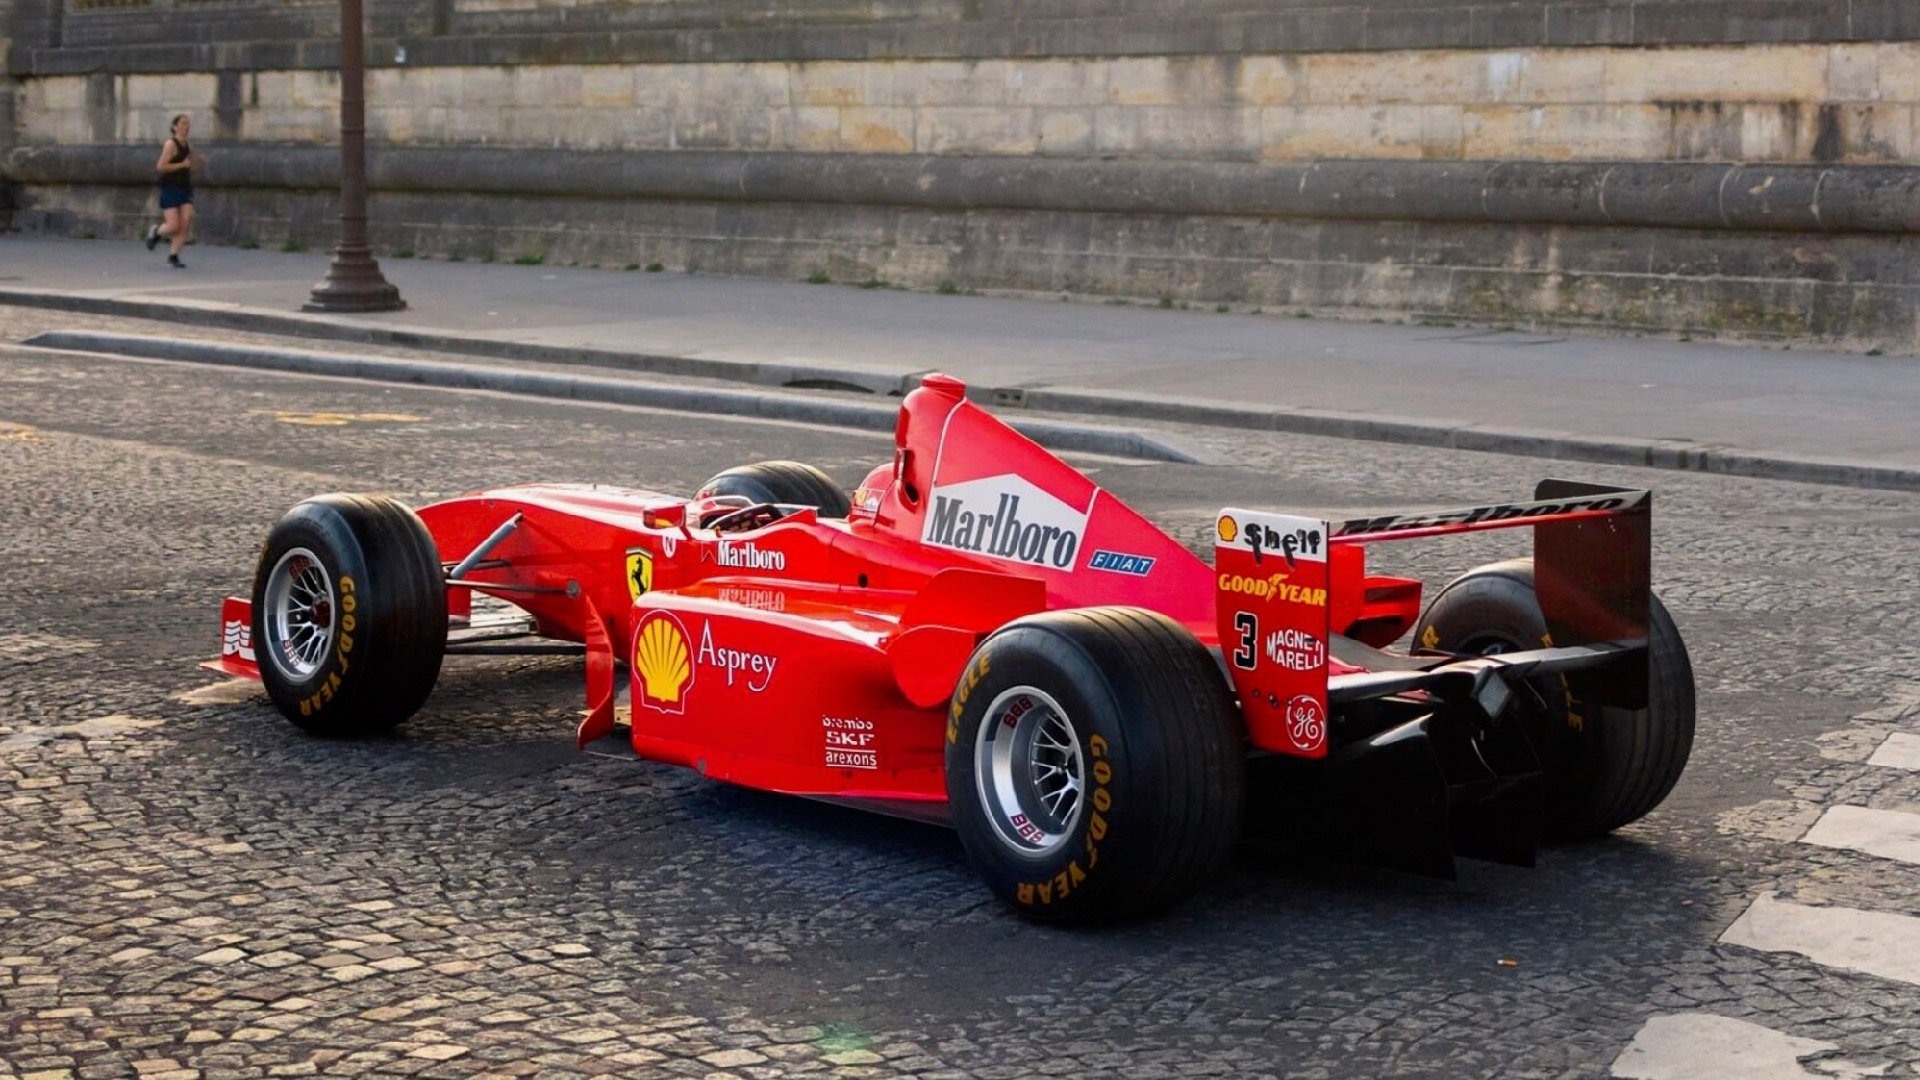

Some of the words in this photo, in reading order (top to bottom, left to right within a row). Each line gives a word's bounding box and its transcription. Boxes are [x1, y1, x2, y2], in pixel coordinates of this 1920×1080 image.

[926, 492, 1077, 568] Marlboro
[1337, 498, 1624, 535] Mlboro
[717, 540, 786, 570] Marlboro
[1093, 553, 1149, 572] FIAT
[697, 618, 777, 692] Asprey
[1233, 611, 1259, 670] 3
[947, 654, 992, 745] EAGLE
[821, 714, 874, 731] brembo
[826, 731, 875, 746] SKF
[825, 751, 878, 766] arexons
